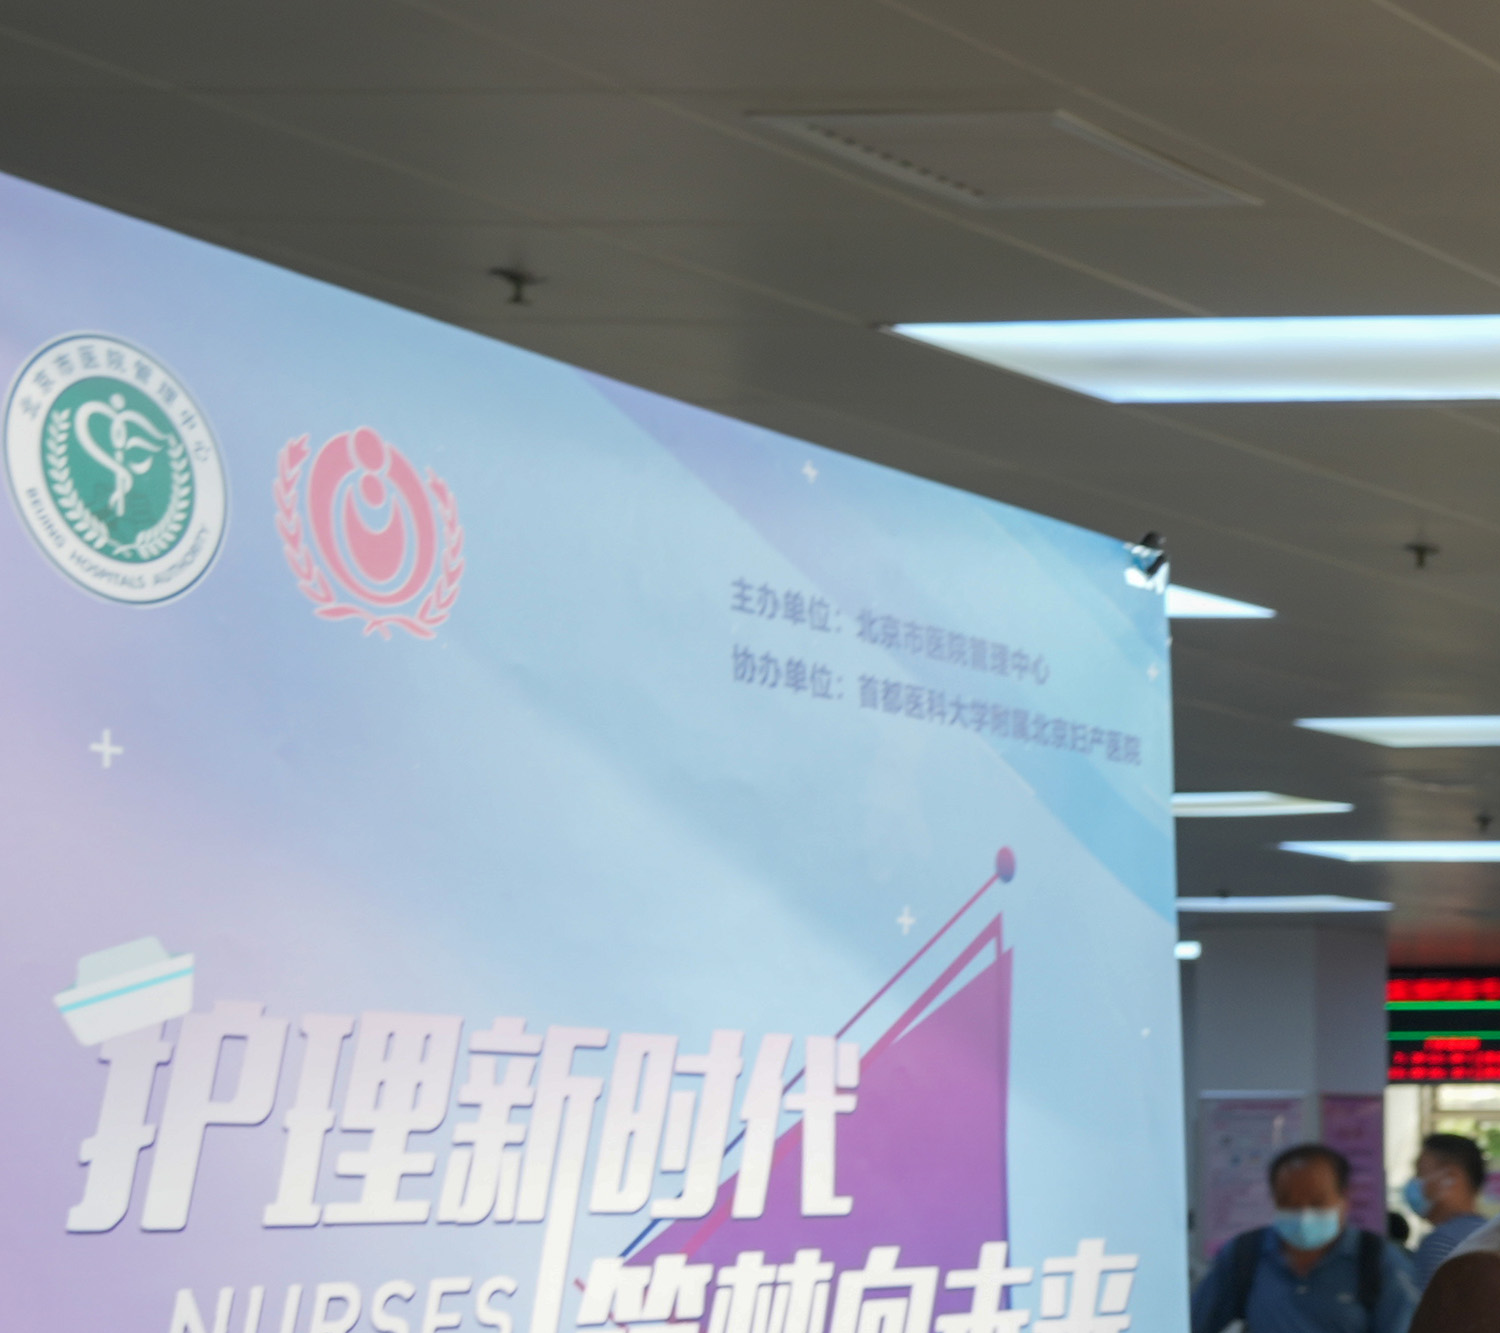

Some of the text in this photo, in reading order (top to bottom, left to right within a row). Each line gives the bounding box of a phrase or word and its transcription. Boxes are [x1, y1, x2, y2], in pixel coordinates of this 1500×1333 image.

[64, 1000, 861, 1236] 护理新时代
